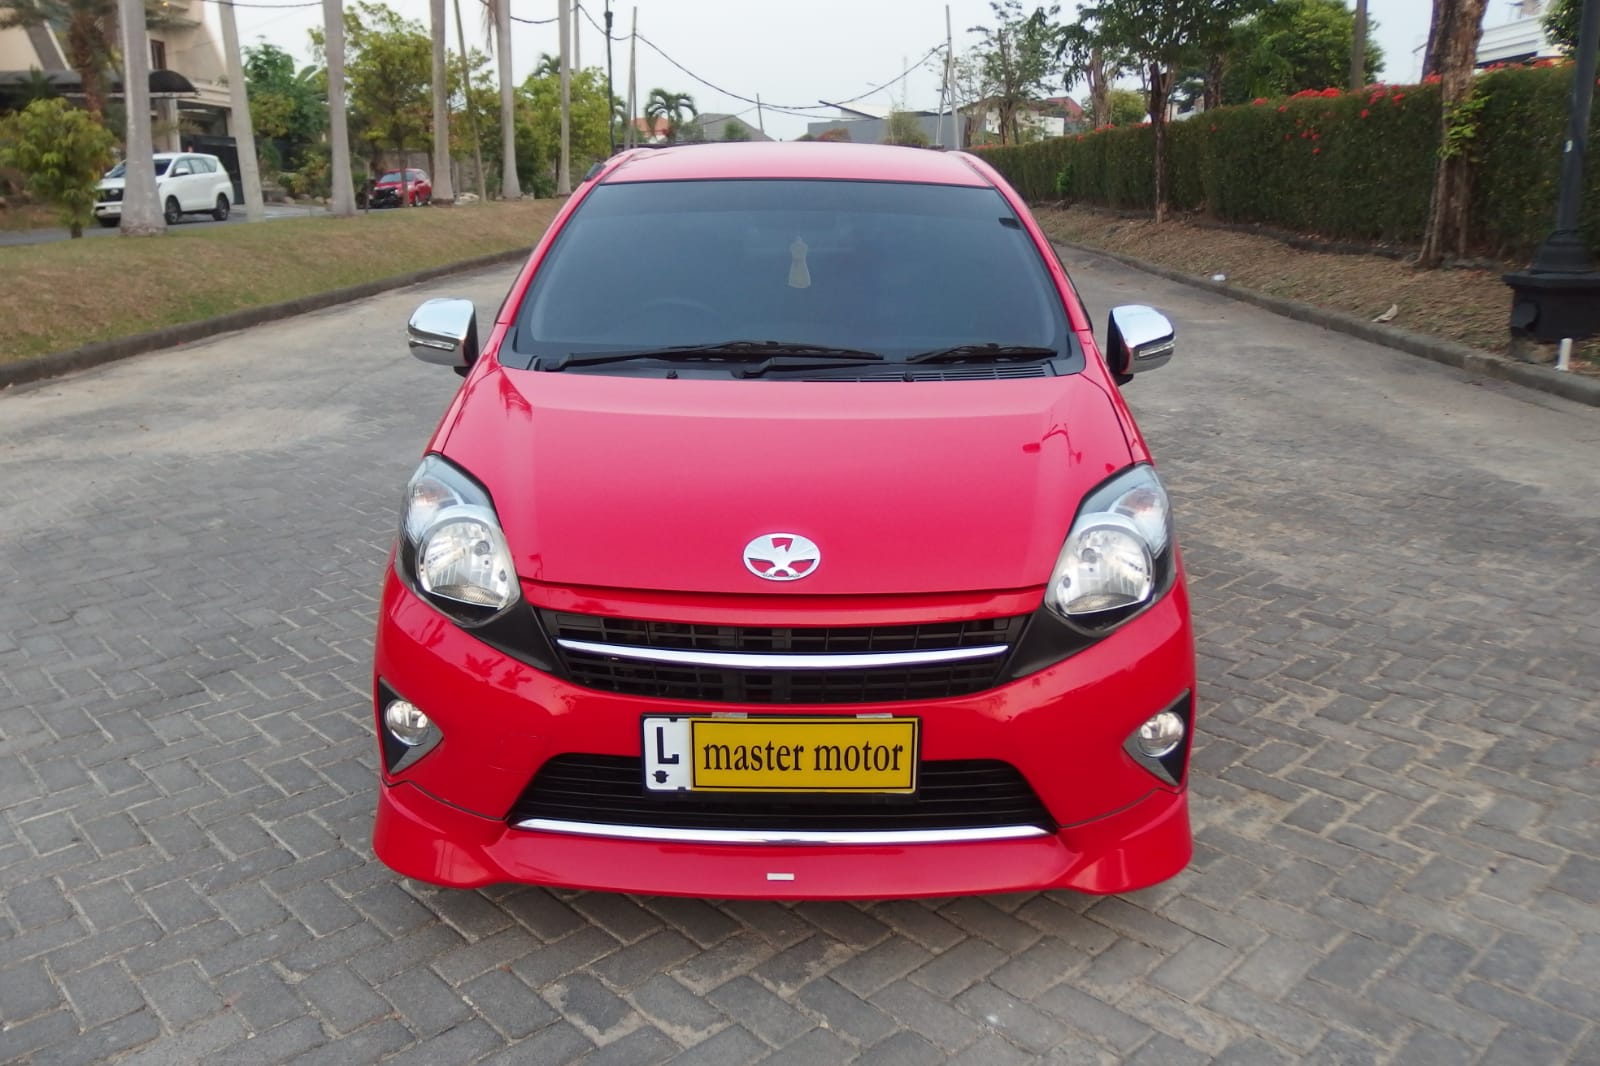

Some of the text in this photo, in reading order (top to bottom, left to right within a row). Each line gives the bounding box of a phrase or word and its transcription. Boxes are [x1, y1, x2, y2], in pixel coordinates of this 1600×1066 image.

[656, 726, 680, 765] L
[703, 740, 904, 771] master motor
